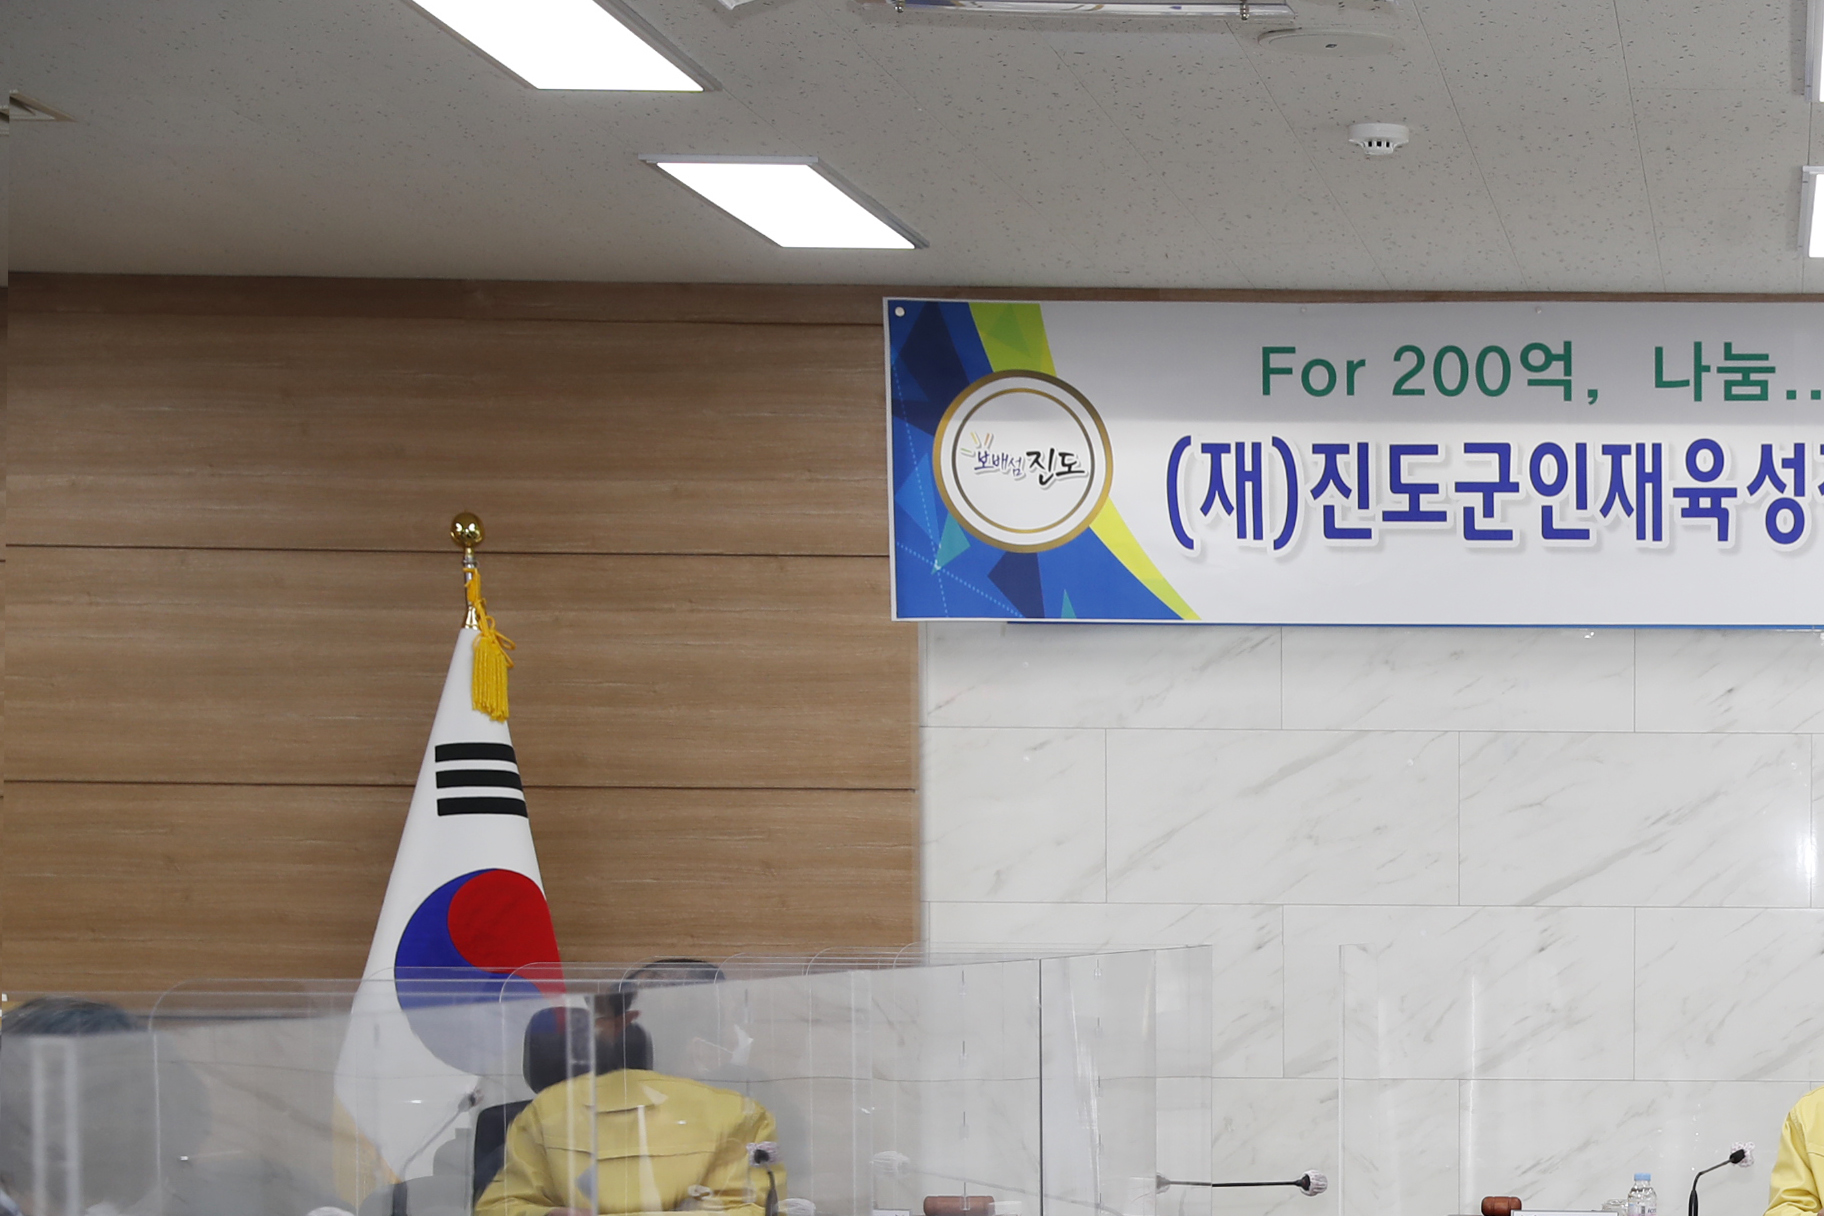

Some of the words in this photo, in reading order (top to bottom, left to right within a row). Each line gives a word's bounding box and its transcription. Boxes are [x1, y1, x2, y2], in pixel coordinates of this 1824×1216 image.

[1263, 346, 1367, 398] For
[1394, 342, 1599, 405] 200억,
[1656, 342, 1822, 403] 나눔..
[974, 450, 1023, 476] 보배섬
[1026, 447, 1086, 486] 진도
